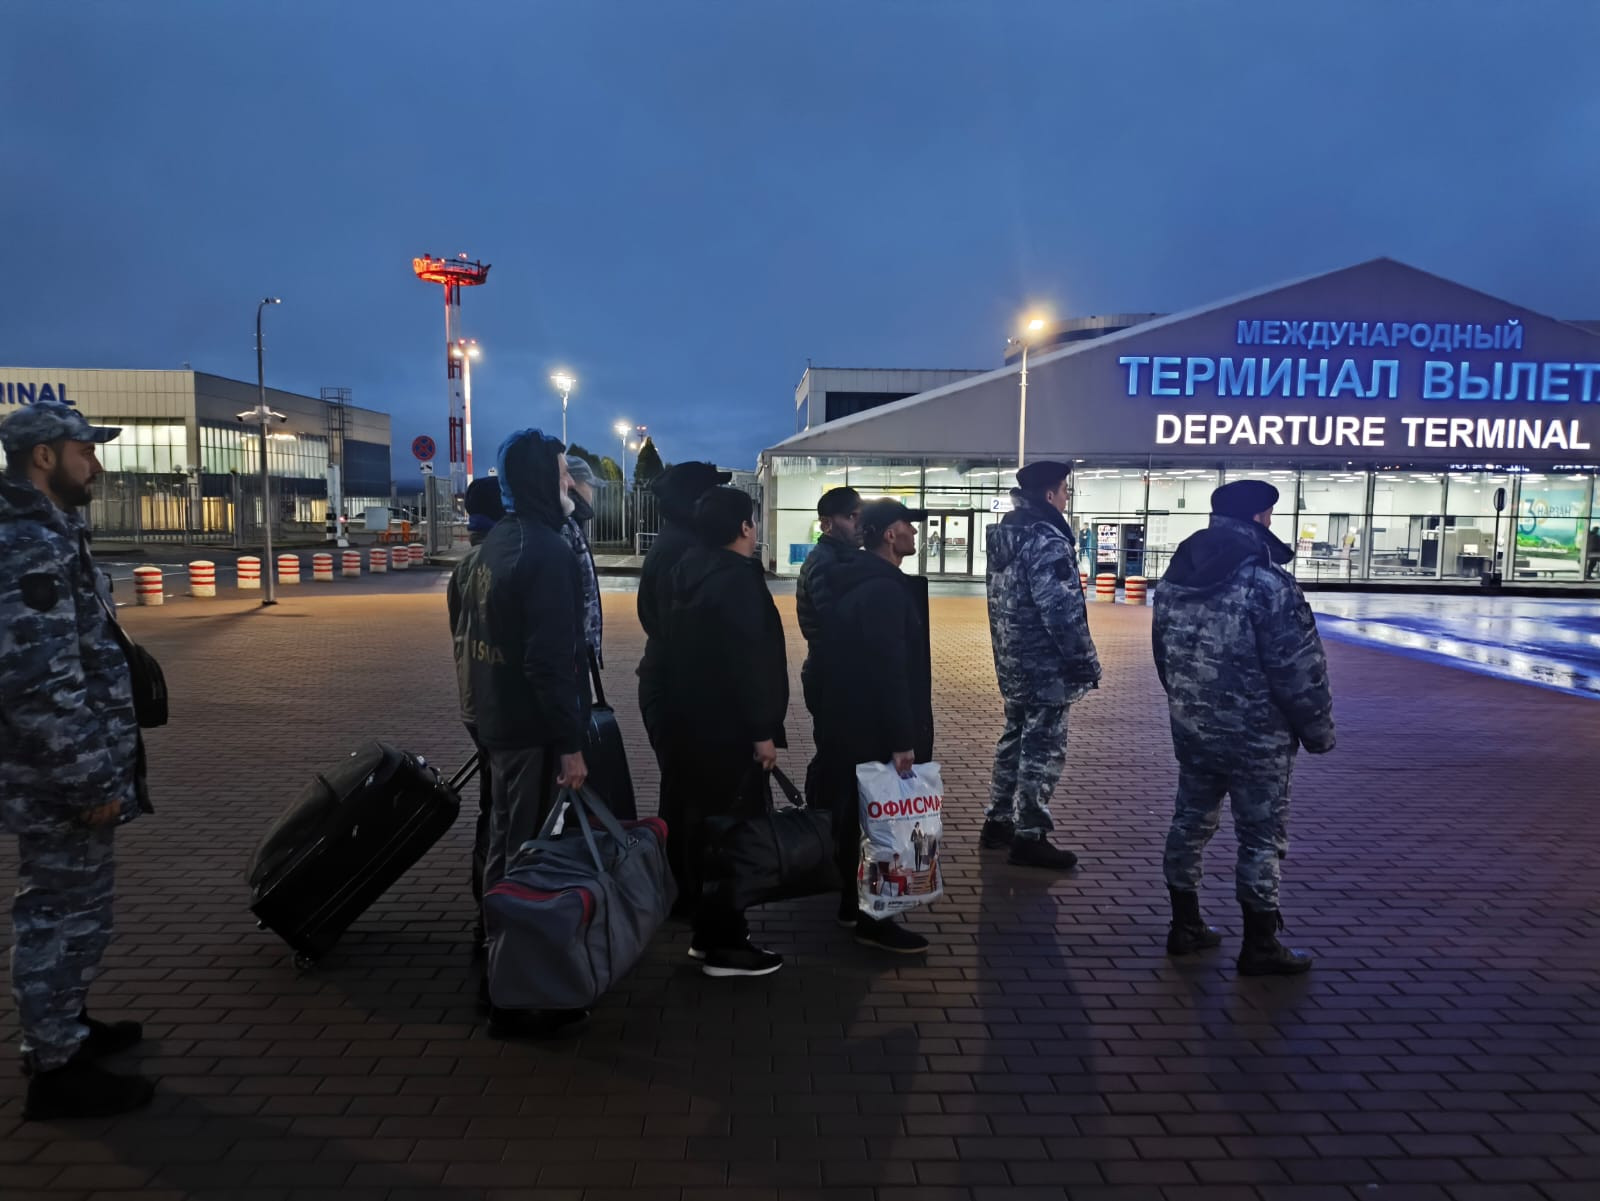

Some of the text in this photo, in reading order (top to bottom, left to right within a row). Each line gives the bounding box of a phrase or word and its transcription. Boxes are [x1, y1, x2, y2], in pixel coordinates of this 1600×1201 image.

[1236, 319, 1524, 352] МЕЖДУНАРОДНЫЙ
[0, 382, 76, 405] INAL
[1119, 356, 1600, 403] ТЕРМИНАЛ ВЫЛЕТ
[1155, 413, 1591, 450] DEPARTURE TERMINAL
[993, 499, 999, 510] 2
[867, 795, 944, 819] ОФИСМА
